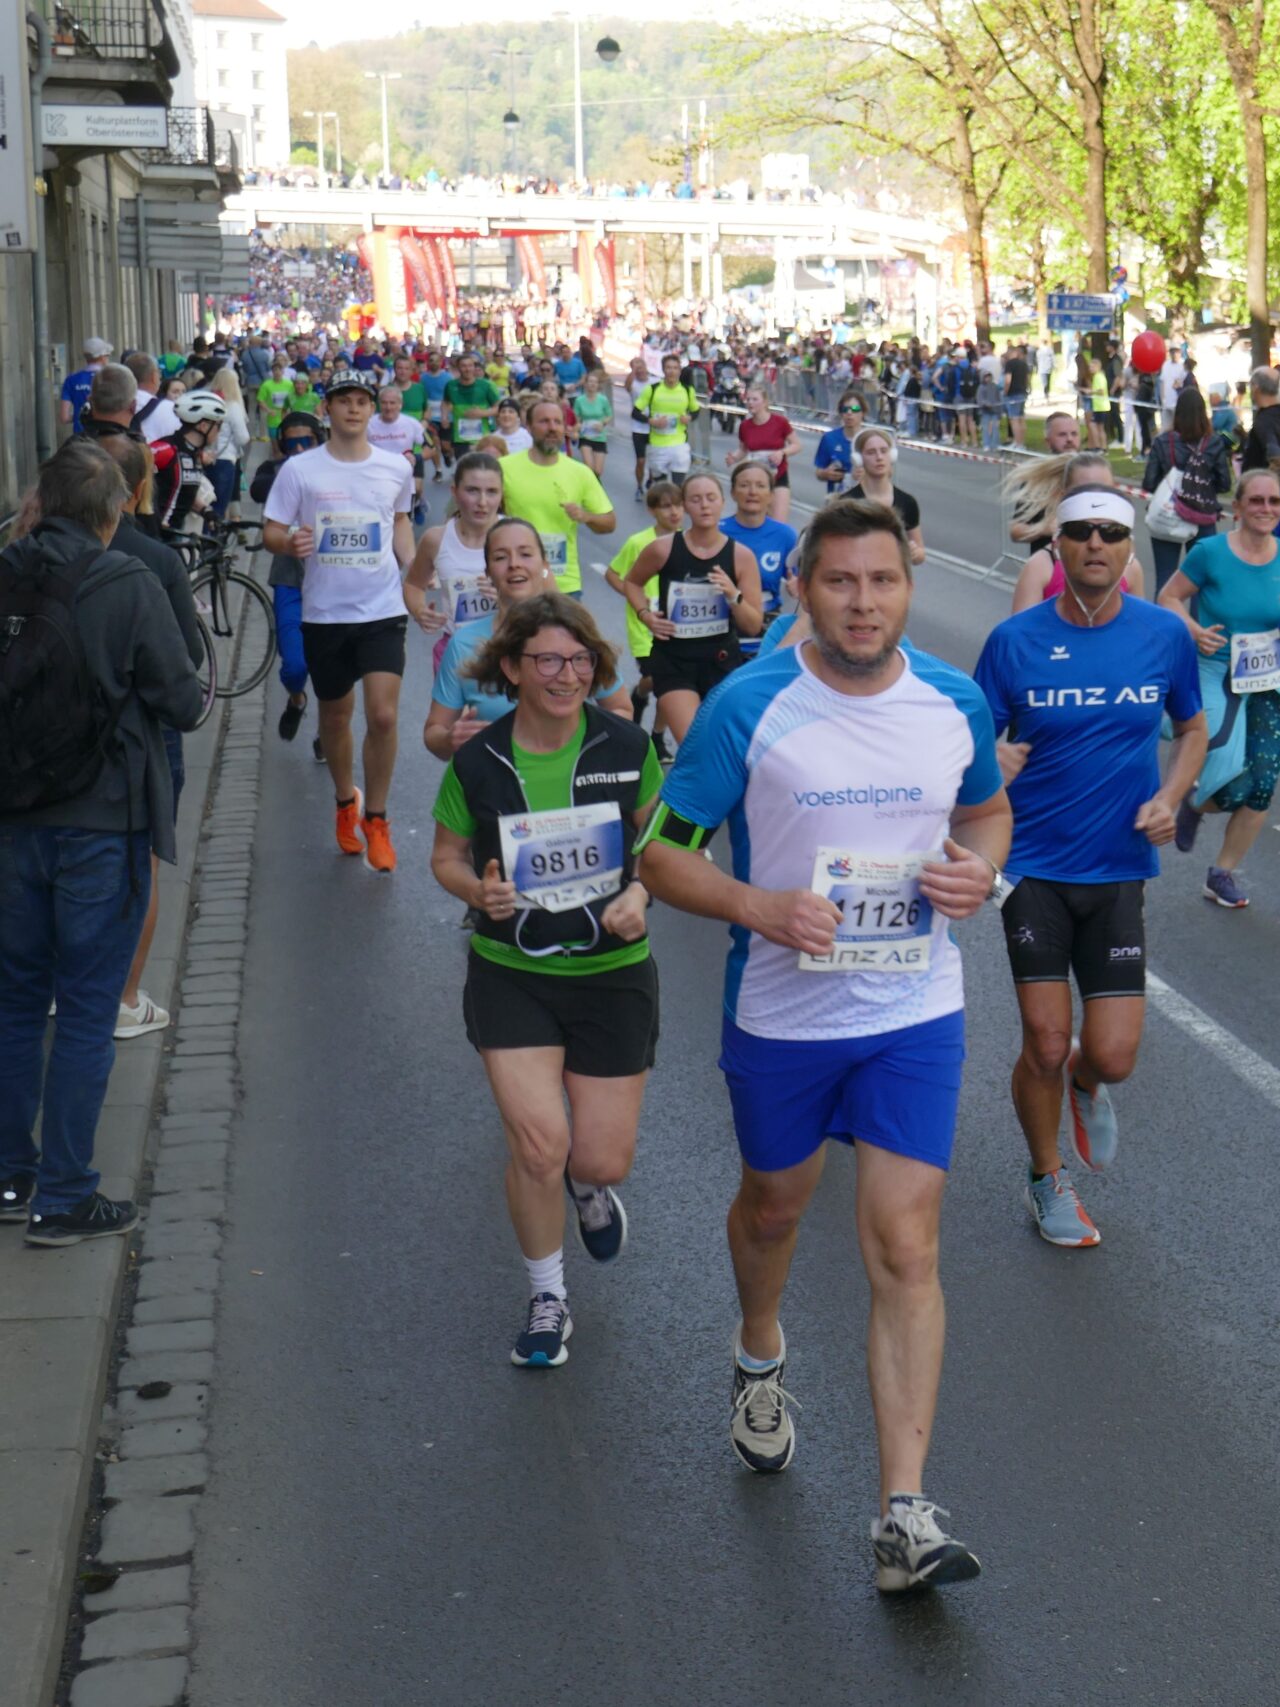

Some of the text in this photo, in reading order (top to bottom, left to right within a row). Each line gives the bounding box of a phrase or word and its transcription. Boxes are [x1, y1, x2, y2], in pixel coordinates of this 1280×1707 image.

[86, 115, 159, 126] Kulturplattform
[86, 126, 160, 138] Oberösterreich
[332, 368, 366, 386] SEXY
[330, 533, 368, 547] 8750
[681, 604, 717, 617] 8314
[1242, 653, 1279, 670] 10701
[1027, 686, 1159, 707] LINZ AG
[793, 784, 923, 808] voestalpine
[530, 846, 600, 877] 9816
[866, 886, 900, 896] Michael
[883, 949, 922, 964] AG
[1109, 946, 1142, 957] DNA
